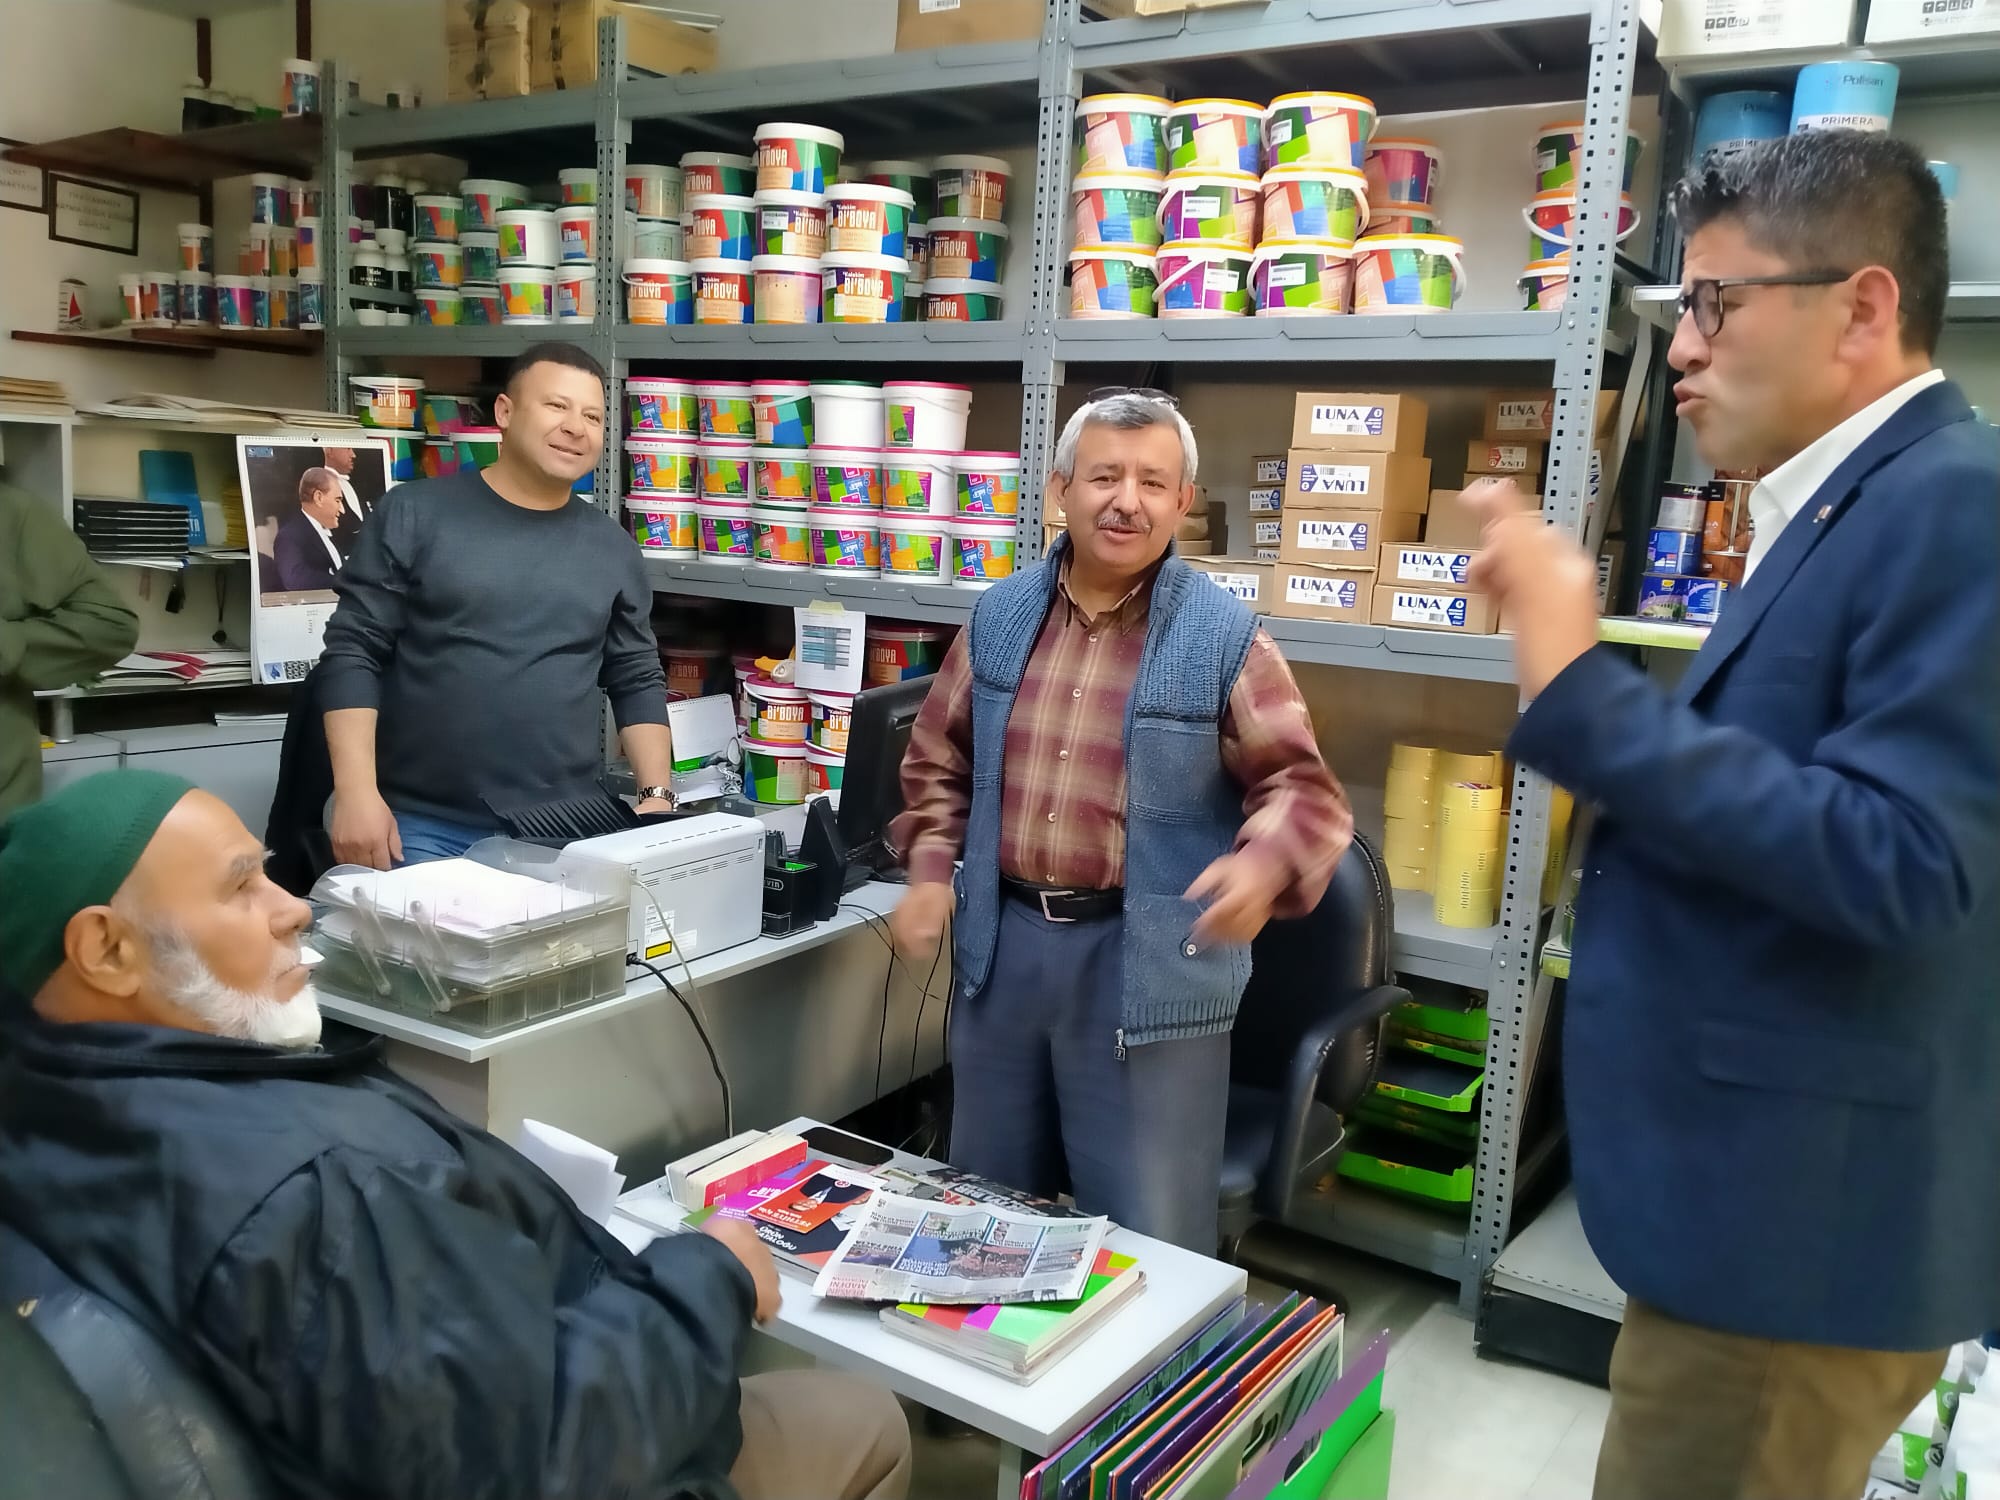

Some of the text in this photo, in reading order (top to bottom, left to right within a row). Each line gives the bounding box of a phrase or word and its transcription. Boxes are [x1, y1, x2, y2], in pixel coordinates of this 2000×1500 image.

[794, 216, 827, 237] BI'BOY
[1315, 408, 1360, 421] LUNA
[1500, 403, 1536, 417] LUNA
[1258, 462, 1278, 470] LUNA
[1322, 479, 1365, 492] LUNA
[1257, 523, 1277, 531] LUNA
[1302, 522, 1345, 536] LUNA
[1402, 552, 1445, 567] LUNA
[1291, 577, 1334, 593] LUNA
[1397, 595, 1441, 610] LUNA
[755, 1229, 797, 1251] ATALOĞU
